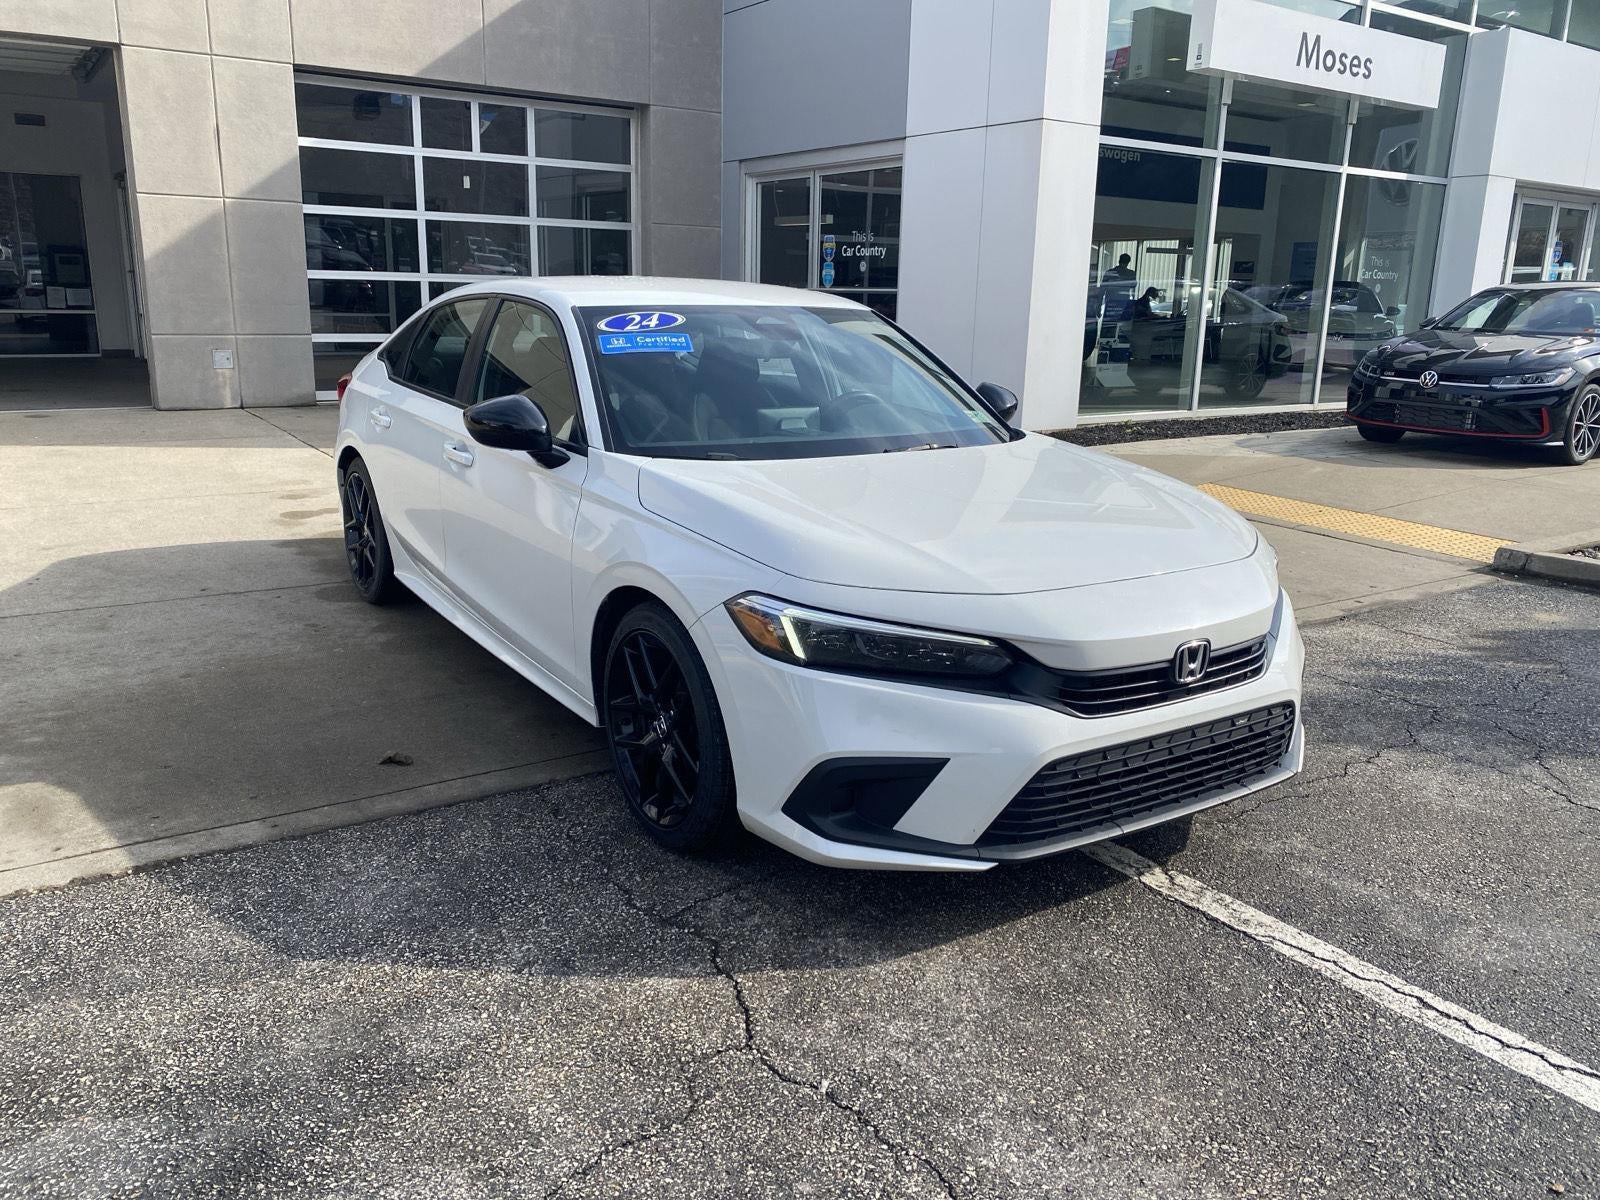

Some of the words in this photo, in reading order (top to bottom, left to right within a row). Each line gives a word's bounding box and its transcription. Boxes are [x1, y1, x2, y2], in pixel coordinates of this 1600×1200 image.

[1296, 31, 1373, 80] Moses
[851, 230, 867, 242] This
[867, 230, 875, 242] is
[841, 245, 854, 257] Car
[855, 245, 887, 259] Country
[1371, 256, 1384, 267] This
[1360, 268, 1372, 279] Car
[1372, 269, 1399, 282] Country
[624, 313, 660, 331] 24
